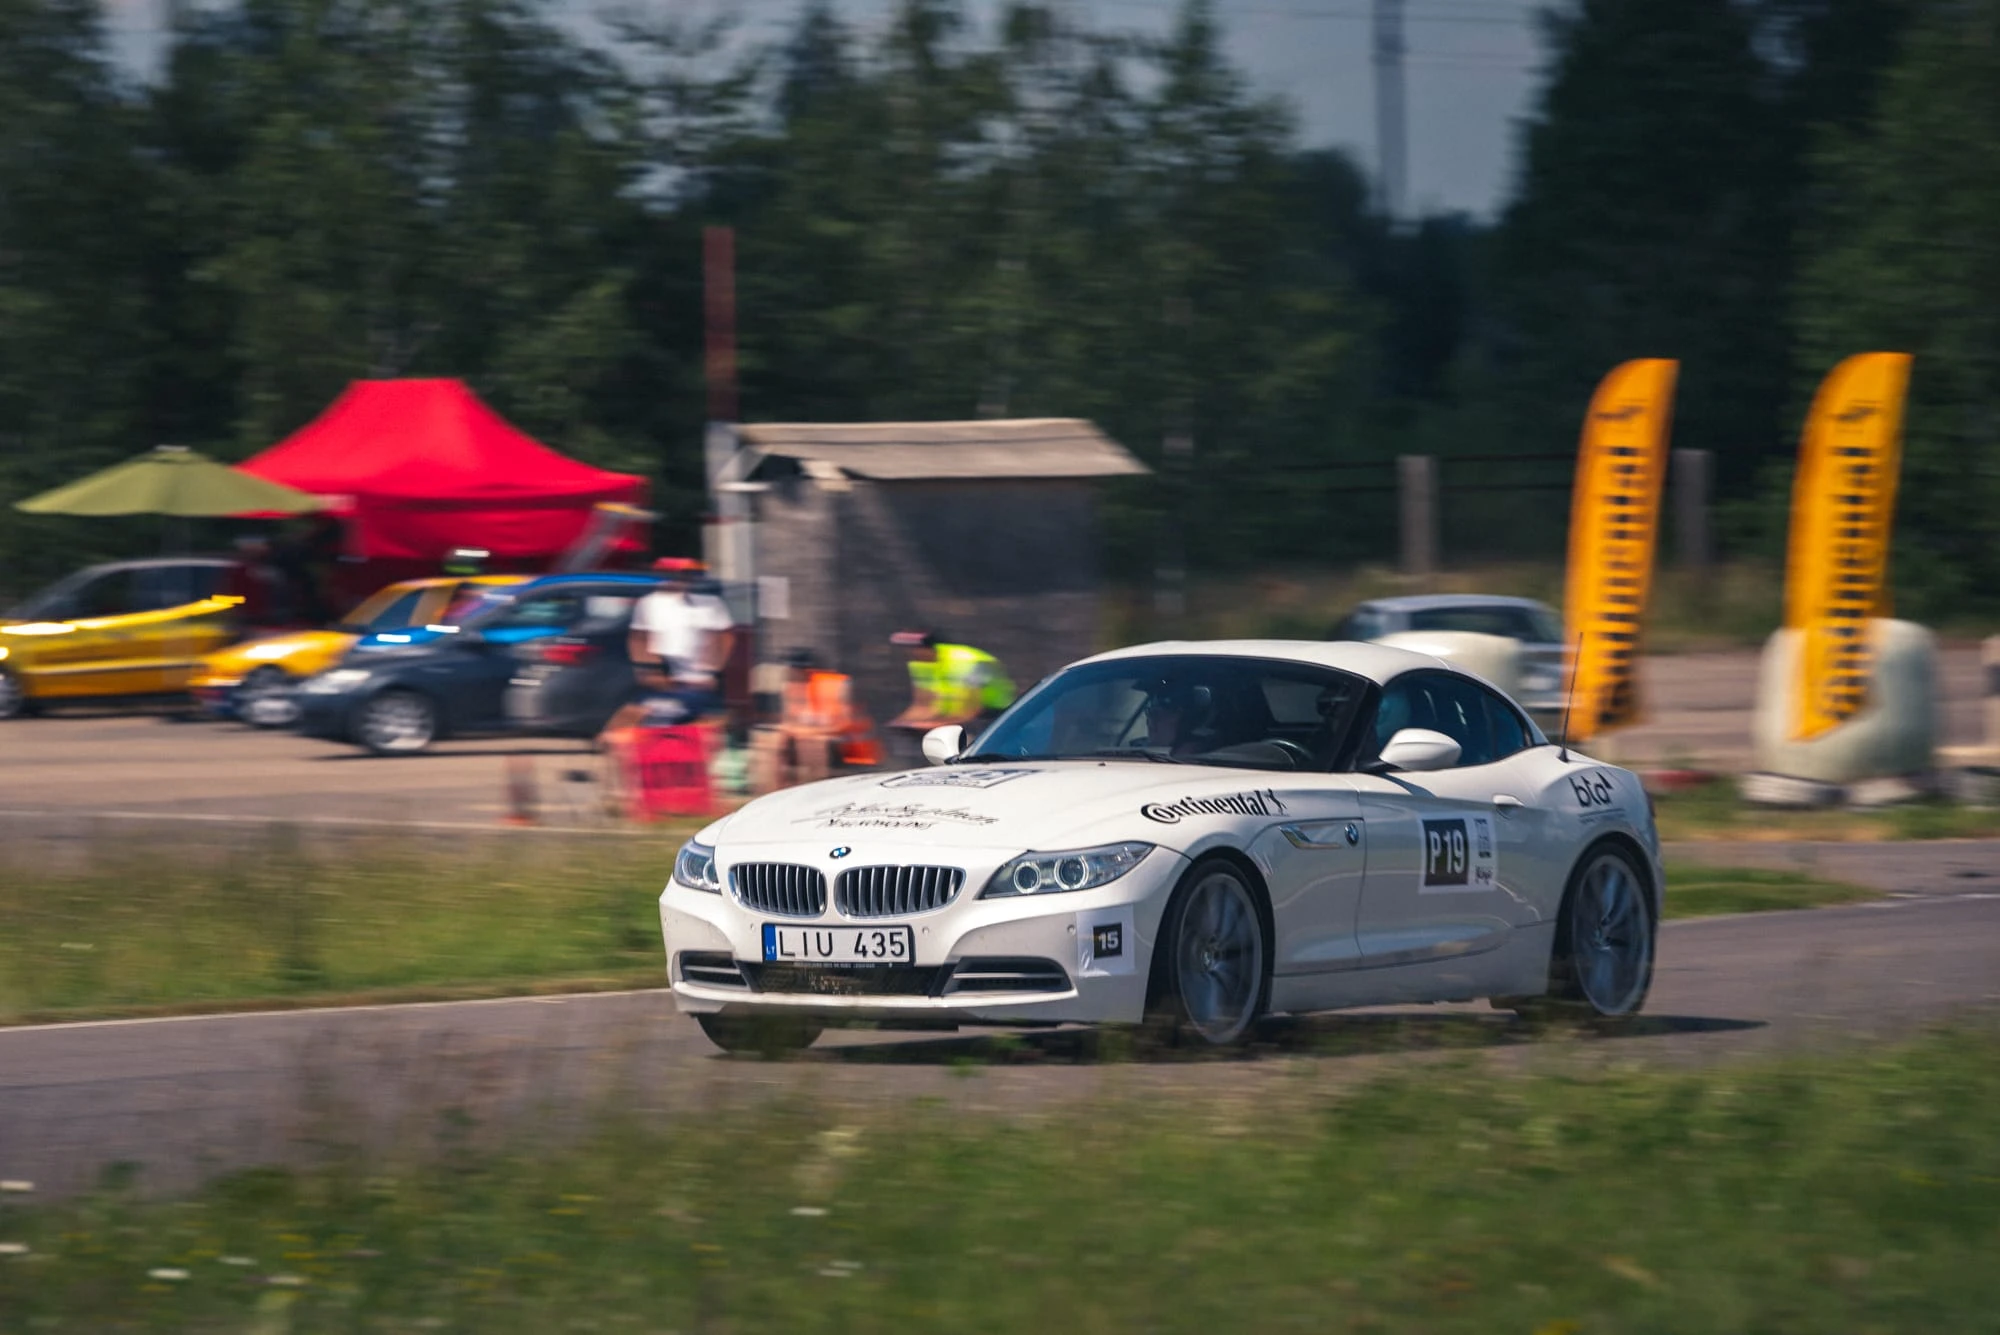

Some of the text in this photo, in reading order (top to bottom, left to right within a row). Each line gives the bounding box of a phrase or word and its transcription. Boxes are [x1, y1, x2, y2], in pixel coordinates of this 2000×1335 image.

[1141, 790, 1271, 824] Continental
[1429, 830, 1465, 874] P19
[766, 945, 775, 955] LT
[779, 930, 905, 957] LIU 435
[1098, 931, 1119, 950] 15
